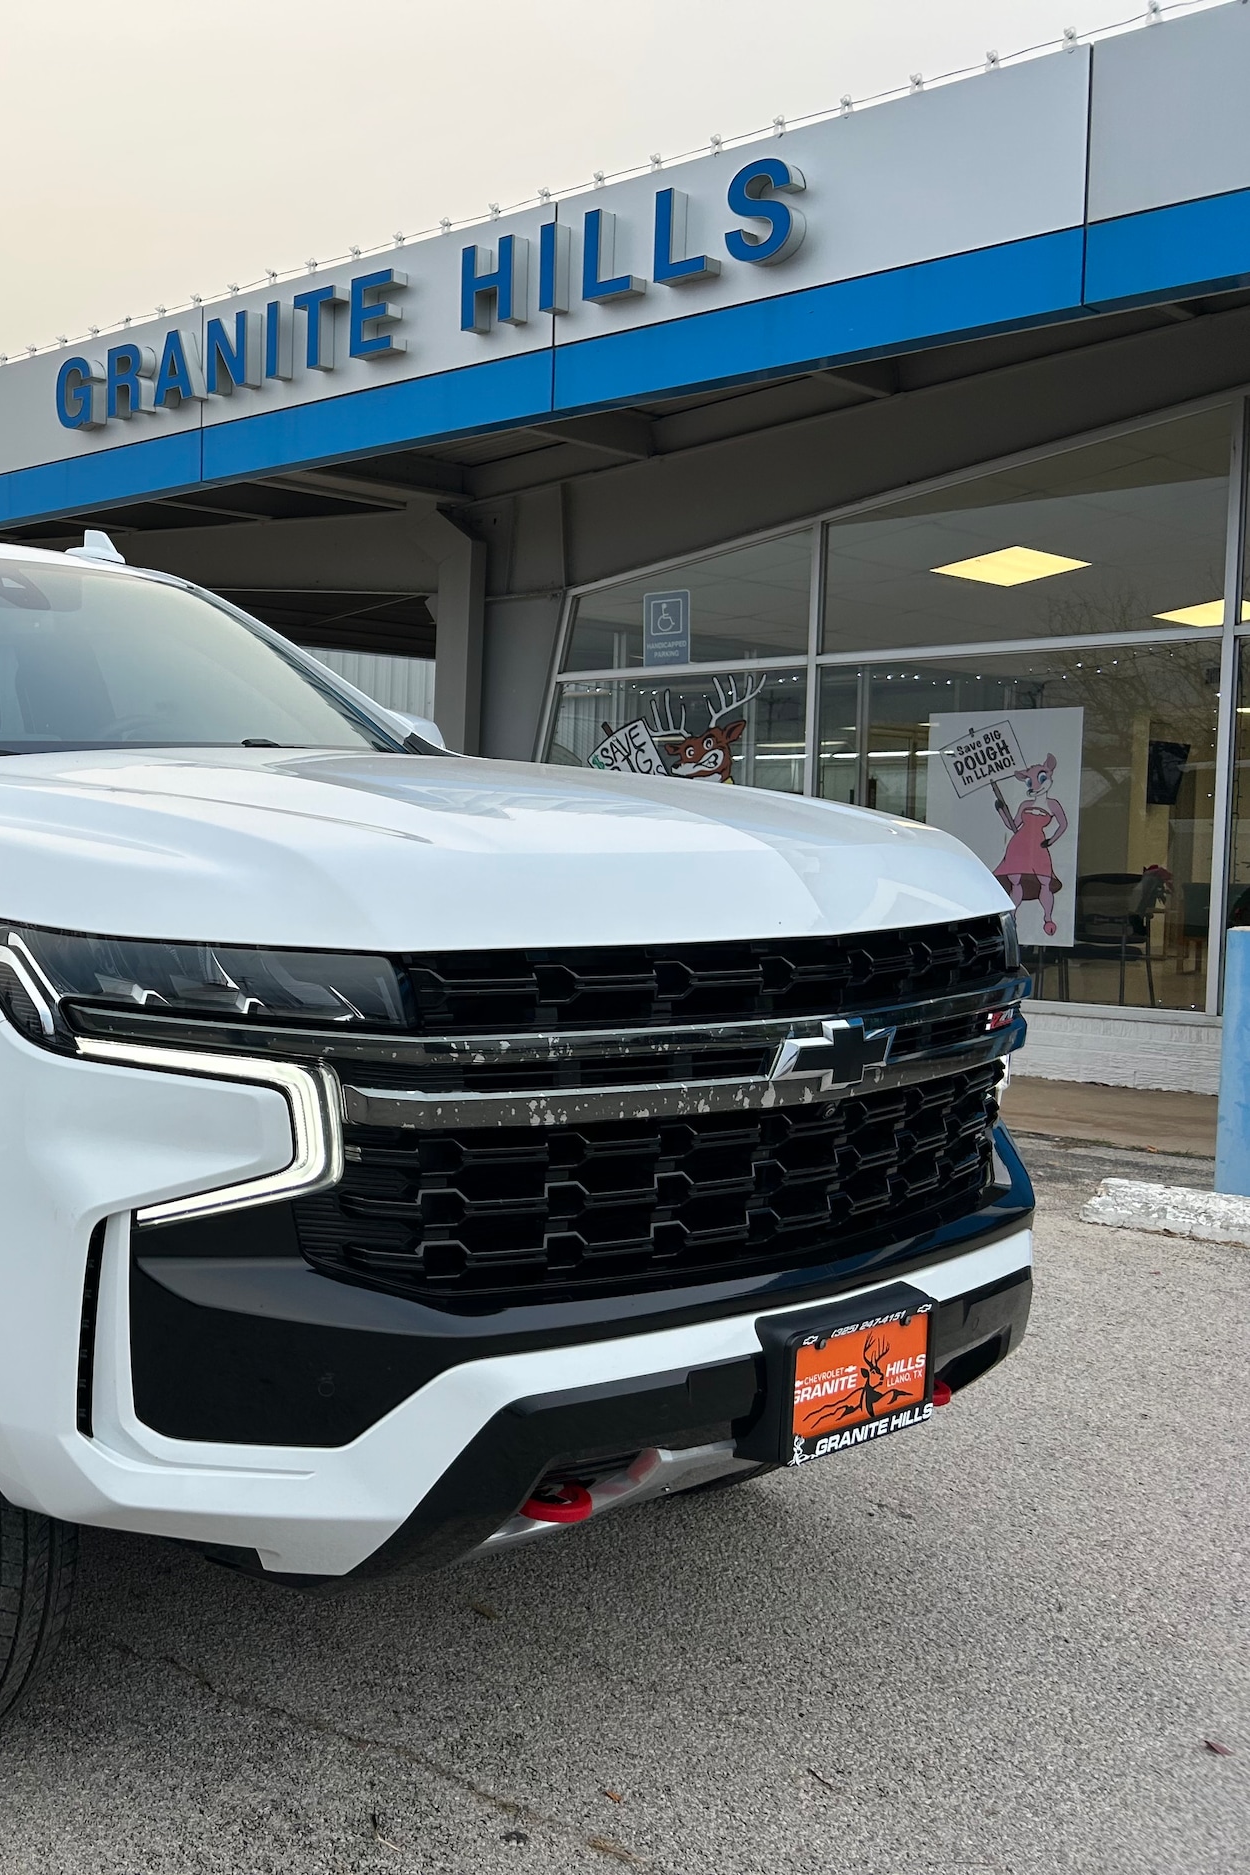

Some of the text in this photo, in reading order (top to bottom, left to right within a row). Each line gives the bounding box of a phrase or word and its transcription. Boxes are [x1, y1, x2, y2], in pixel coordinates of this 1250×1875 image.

[55, 157, 807, 431] GRANITE HILLS
[646, 640, 687, 650] HANDICAPPED
[653, 650, 680, 659] PARKING
[600, 724, 647, 767] SAVE
[956, 730, 1001, 756] Save BIG
[953, 739, 1011, 776] DOUGH
[973, 755, 1016, 780] LLANO!
[804, 1366, 845, 1385] CHEVROLET
[885, 1353, 927, 1378] HILLS
[793, 1373, 858, 1405] GRANITE
[886, 1369, 923, 1388] LLANO, TX
[815, 1402, 934, 1456] GRANITE HILLS
